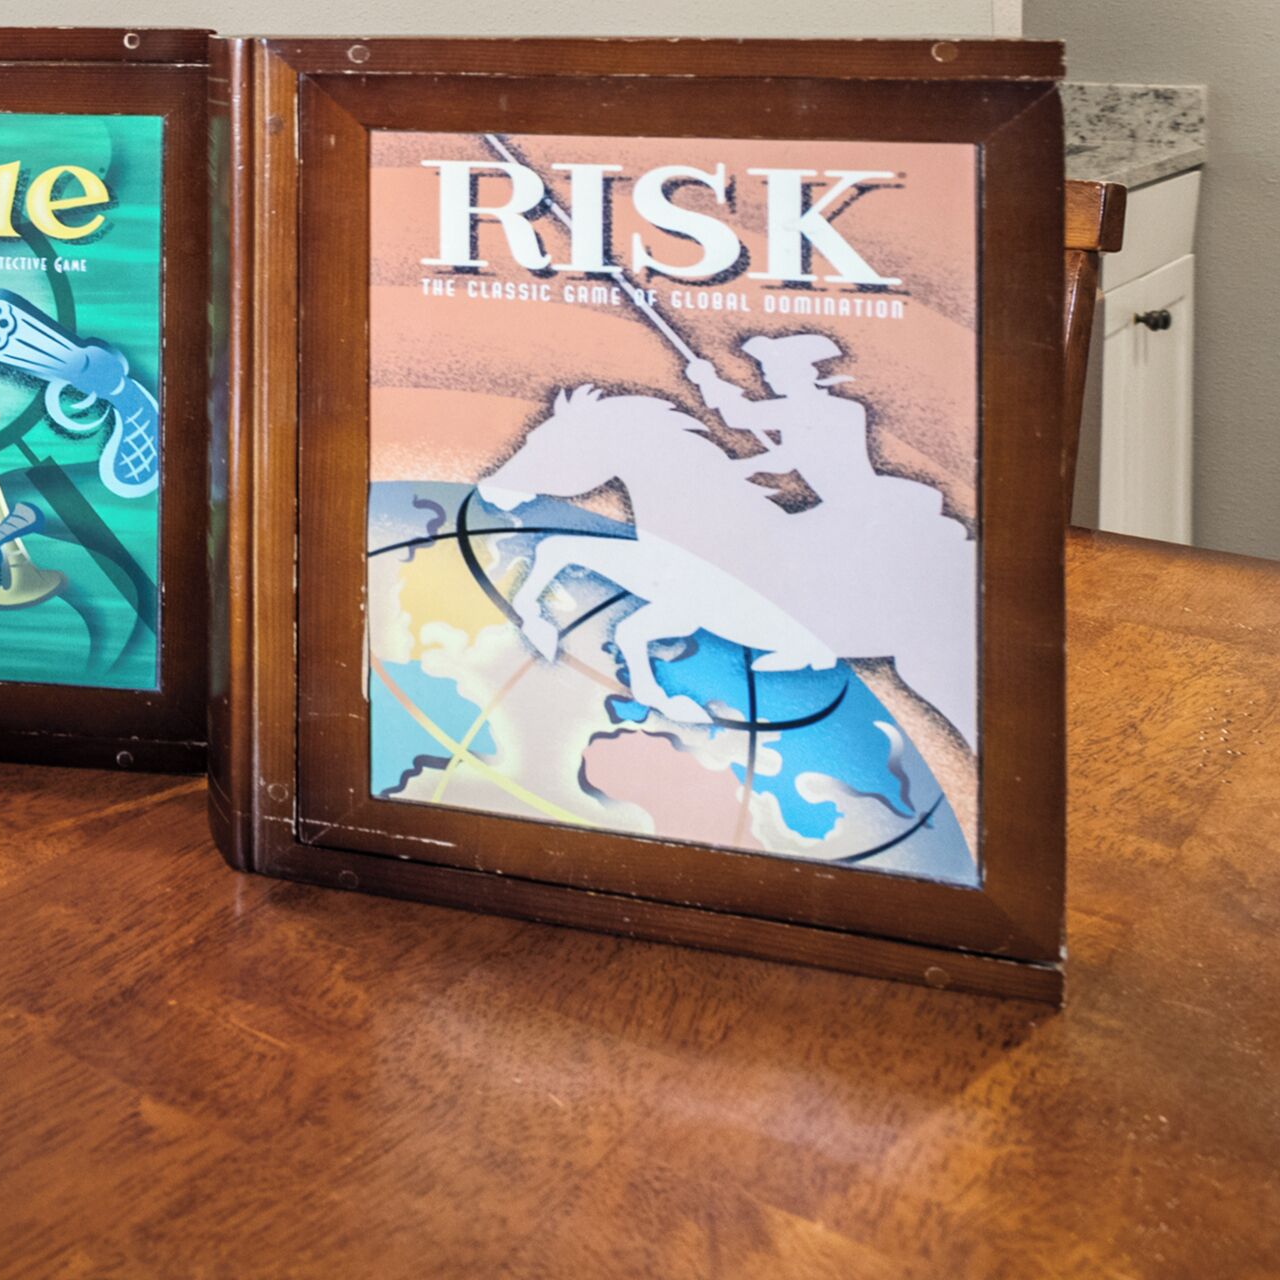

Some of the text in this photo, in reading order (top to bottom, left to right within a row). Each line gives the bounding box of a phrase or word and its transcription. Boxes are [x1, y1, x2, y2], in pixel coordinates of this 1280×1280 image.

[420, 160, 904, 286] RISK
[53, 256, 88, 273] GAME
[421, 278, 904, 319] THE CLASSIC GAME OF GLOBAL DOMINATION
